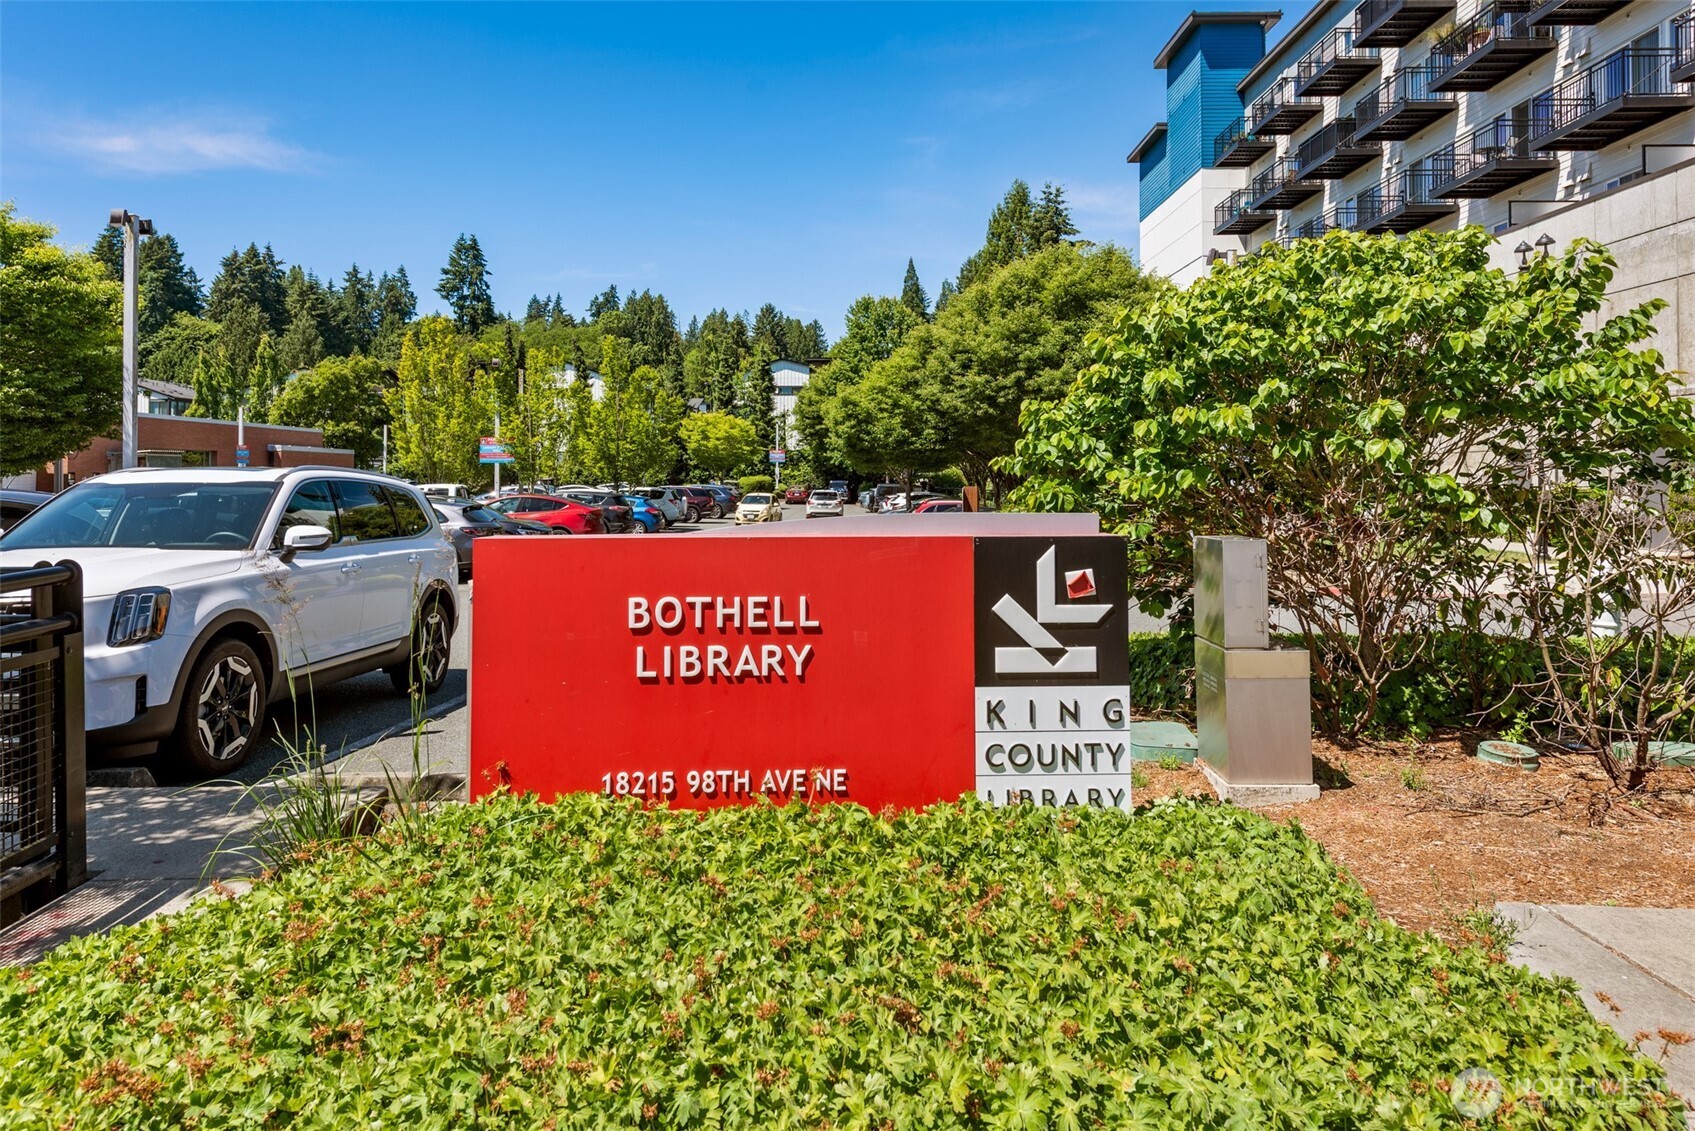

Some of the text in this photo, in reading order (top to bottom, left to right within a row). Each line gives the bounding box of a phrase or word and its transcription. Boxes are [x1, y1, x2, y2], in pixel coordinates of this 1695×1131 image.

[628, 596, 820, 629] BOTHELL
[636, 644, 812, 678] LIBRARY
[986, 699, 1123, 723] KING
[985, 743, 1123, 767] COUNTY
[601, 768, 847, 795] 18215 98TH AVE NE
